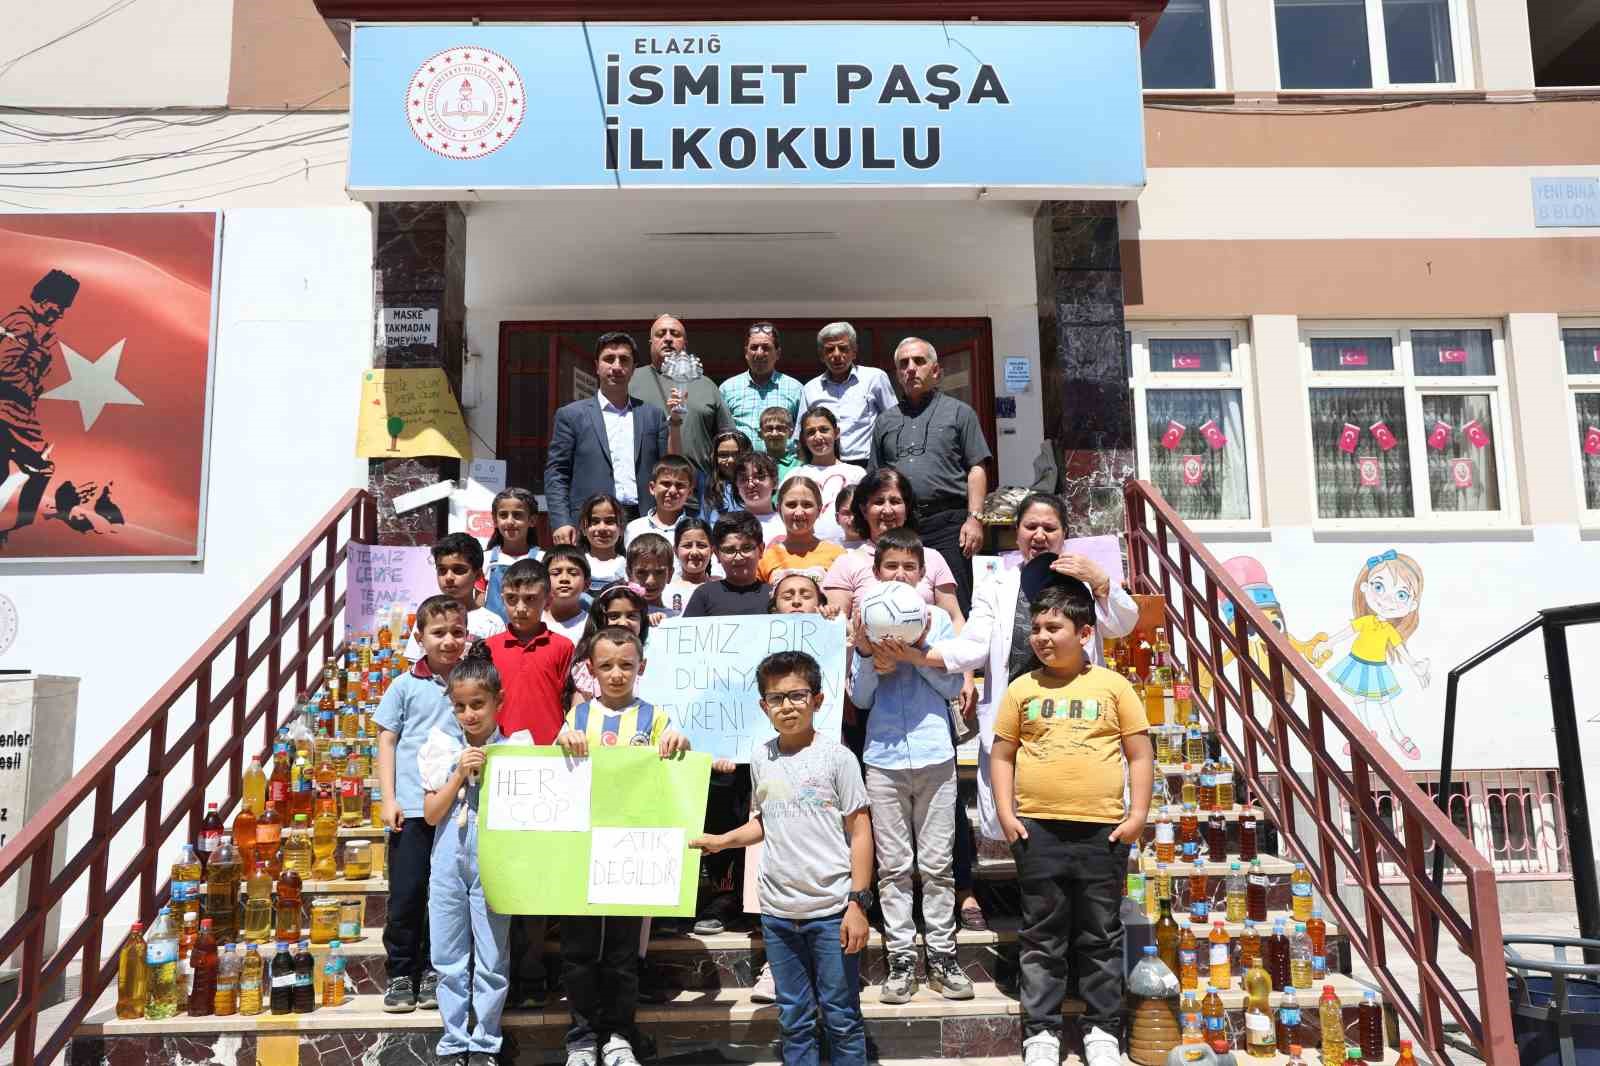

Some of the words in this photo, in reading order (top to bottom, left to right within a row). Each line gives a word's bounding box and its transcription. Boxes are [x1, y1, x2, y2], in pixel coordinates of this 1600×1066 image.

[634, 38, 721, 54] ELAZIĞ
[606, 54, 808, 105] İSMET
[835, 64, 1011, 110] PAŞA
[605, 116, 941, 170] İLKOKULU
[393, 310, 424, 320] MASKE
[384, 323, 432, 333] TAKMADAN
[658, 623, 741, 655] TEMIZ
[0, 730, 31, 747] enler
[0, 751, 21, 769] esil
[496, 767, 559, 797] HER
